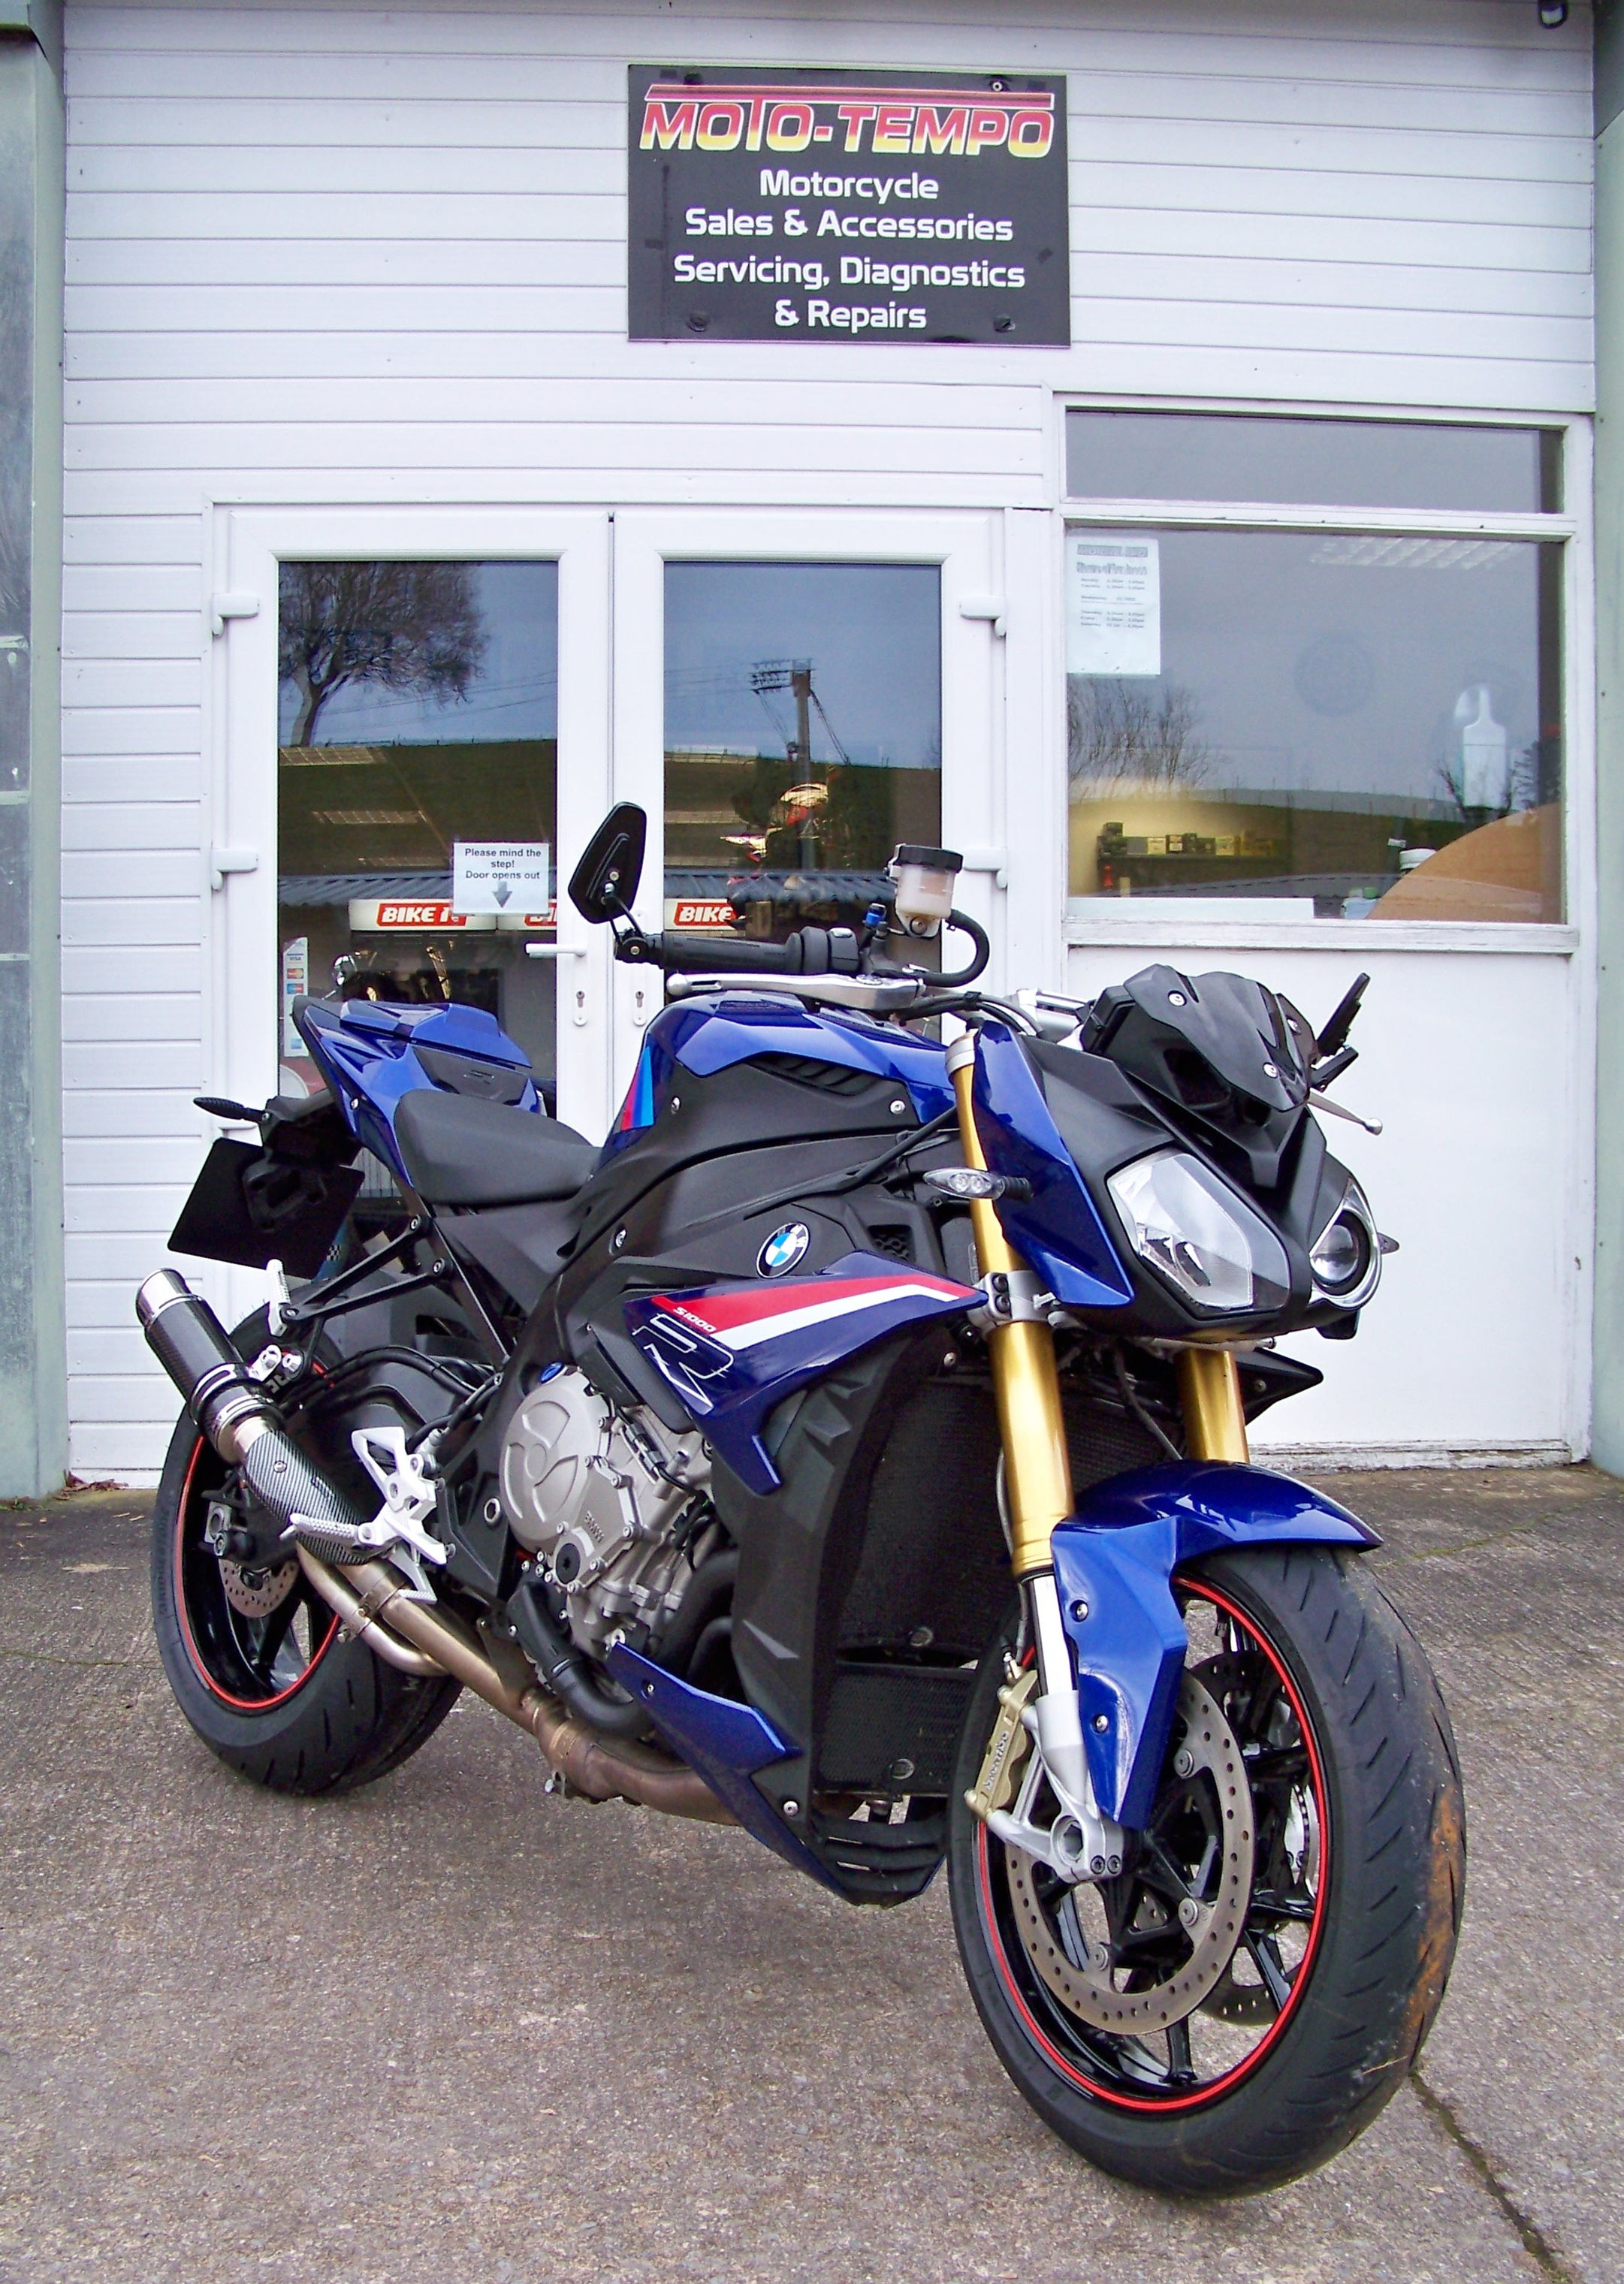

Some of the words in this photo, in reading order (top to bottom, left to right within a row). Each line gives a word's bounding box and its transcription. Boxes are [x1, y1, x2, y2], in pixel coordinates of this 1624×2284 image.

[639, 84, 1055, 158] MOTO-TEMPO
[759, 169, 939, 205] Motorcycle
[685, 207, 774, 236] Sales
[783, 209, 809, 237] &
[817, 209, 1013, 241] Accessories
[674, 255, 830, 291] Servicing,
[840, 256, 1025, 291] Diagnostics
[774, 299, 800, 327] &
[807, 300, 927, 333] Repairs
[465, 848, 497, 857] Please
[500, 849, 524, 857] mind
[527, 849, 542, 857] the
[491, 859, 515, 869] step!
[466, 870, 489, 879] Door
[492, 872, 521, 880] opens
[382, 907, 436, 922] BIKE
[679, 907, 734, 922] BIKE
[674, 1307, 717, 1333] S1000
